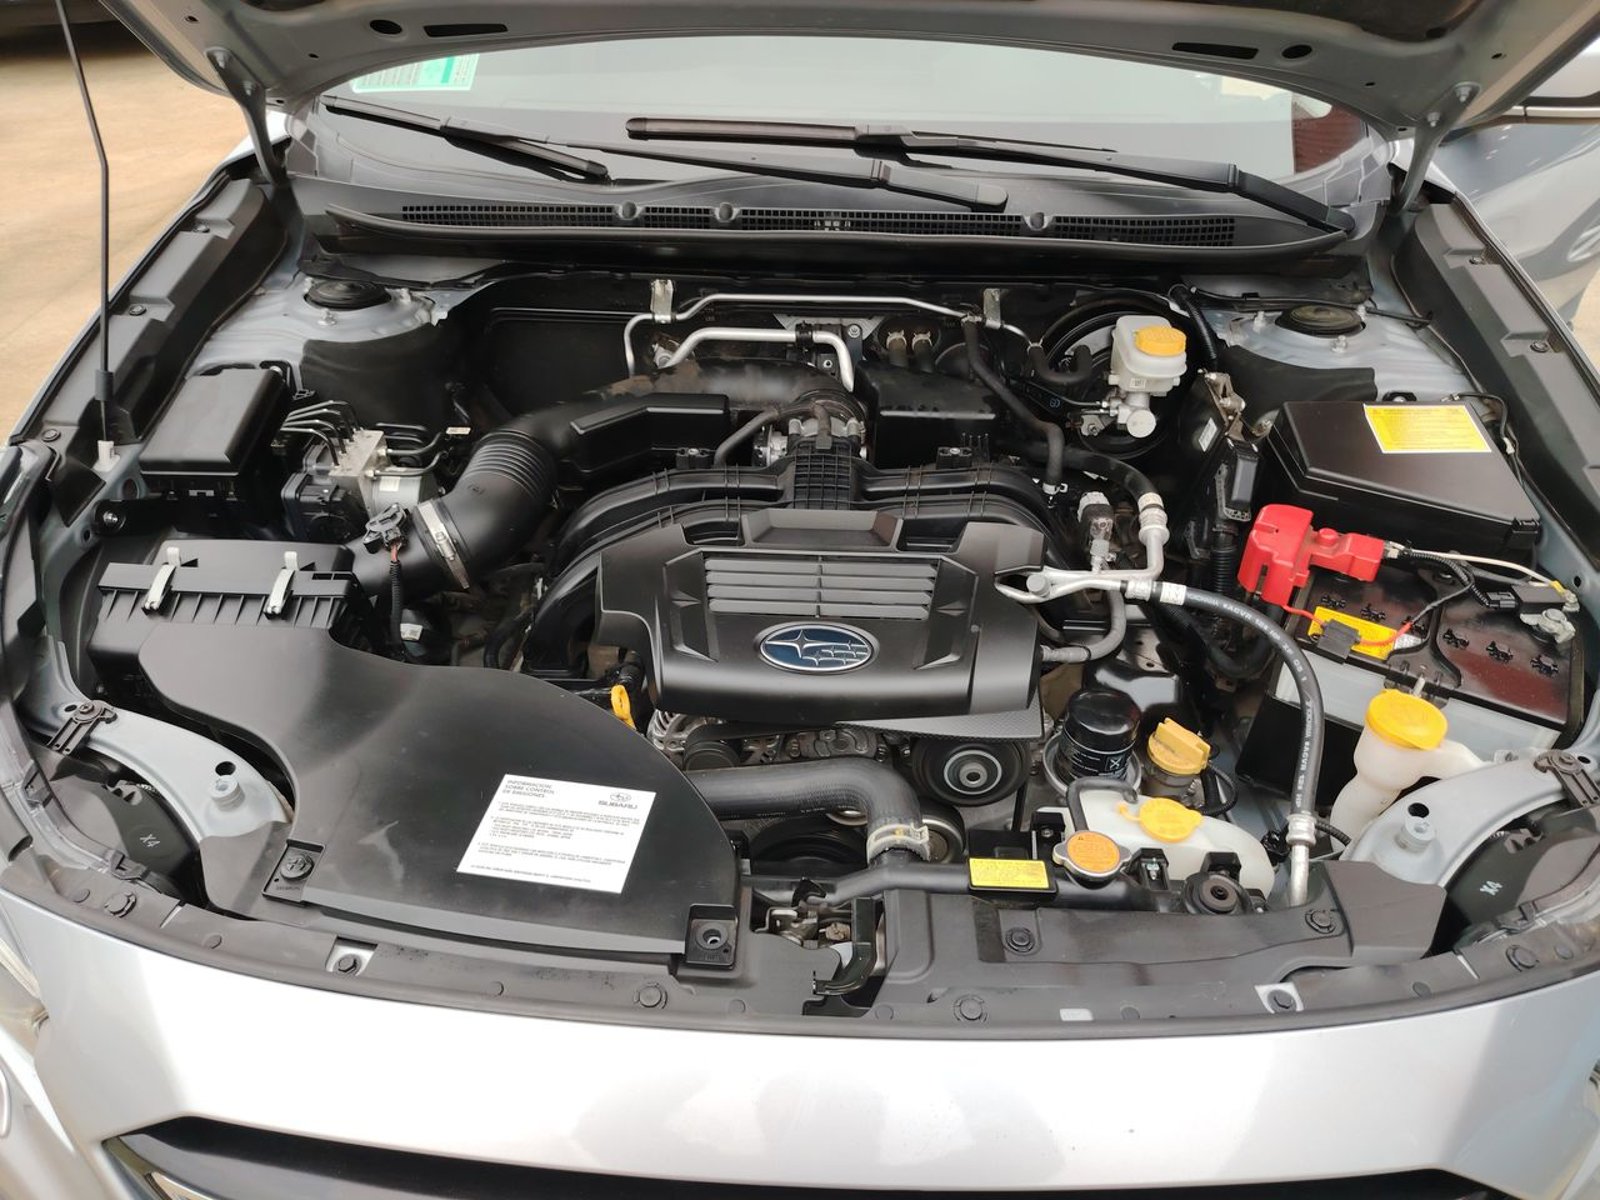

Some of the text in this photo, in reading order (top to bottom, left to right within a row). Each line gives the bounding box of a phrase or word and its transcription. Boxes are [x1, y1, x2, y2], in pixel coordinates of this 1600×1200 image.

[598, 800, 638, 809] SUBARU
[140, 833, 160, 847] X4
[1480, 880, 1503, 895] X4
